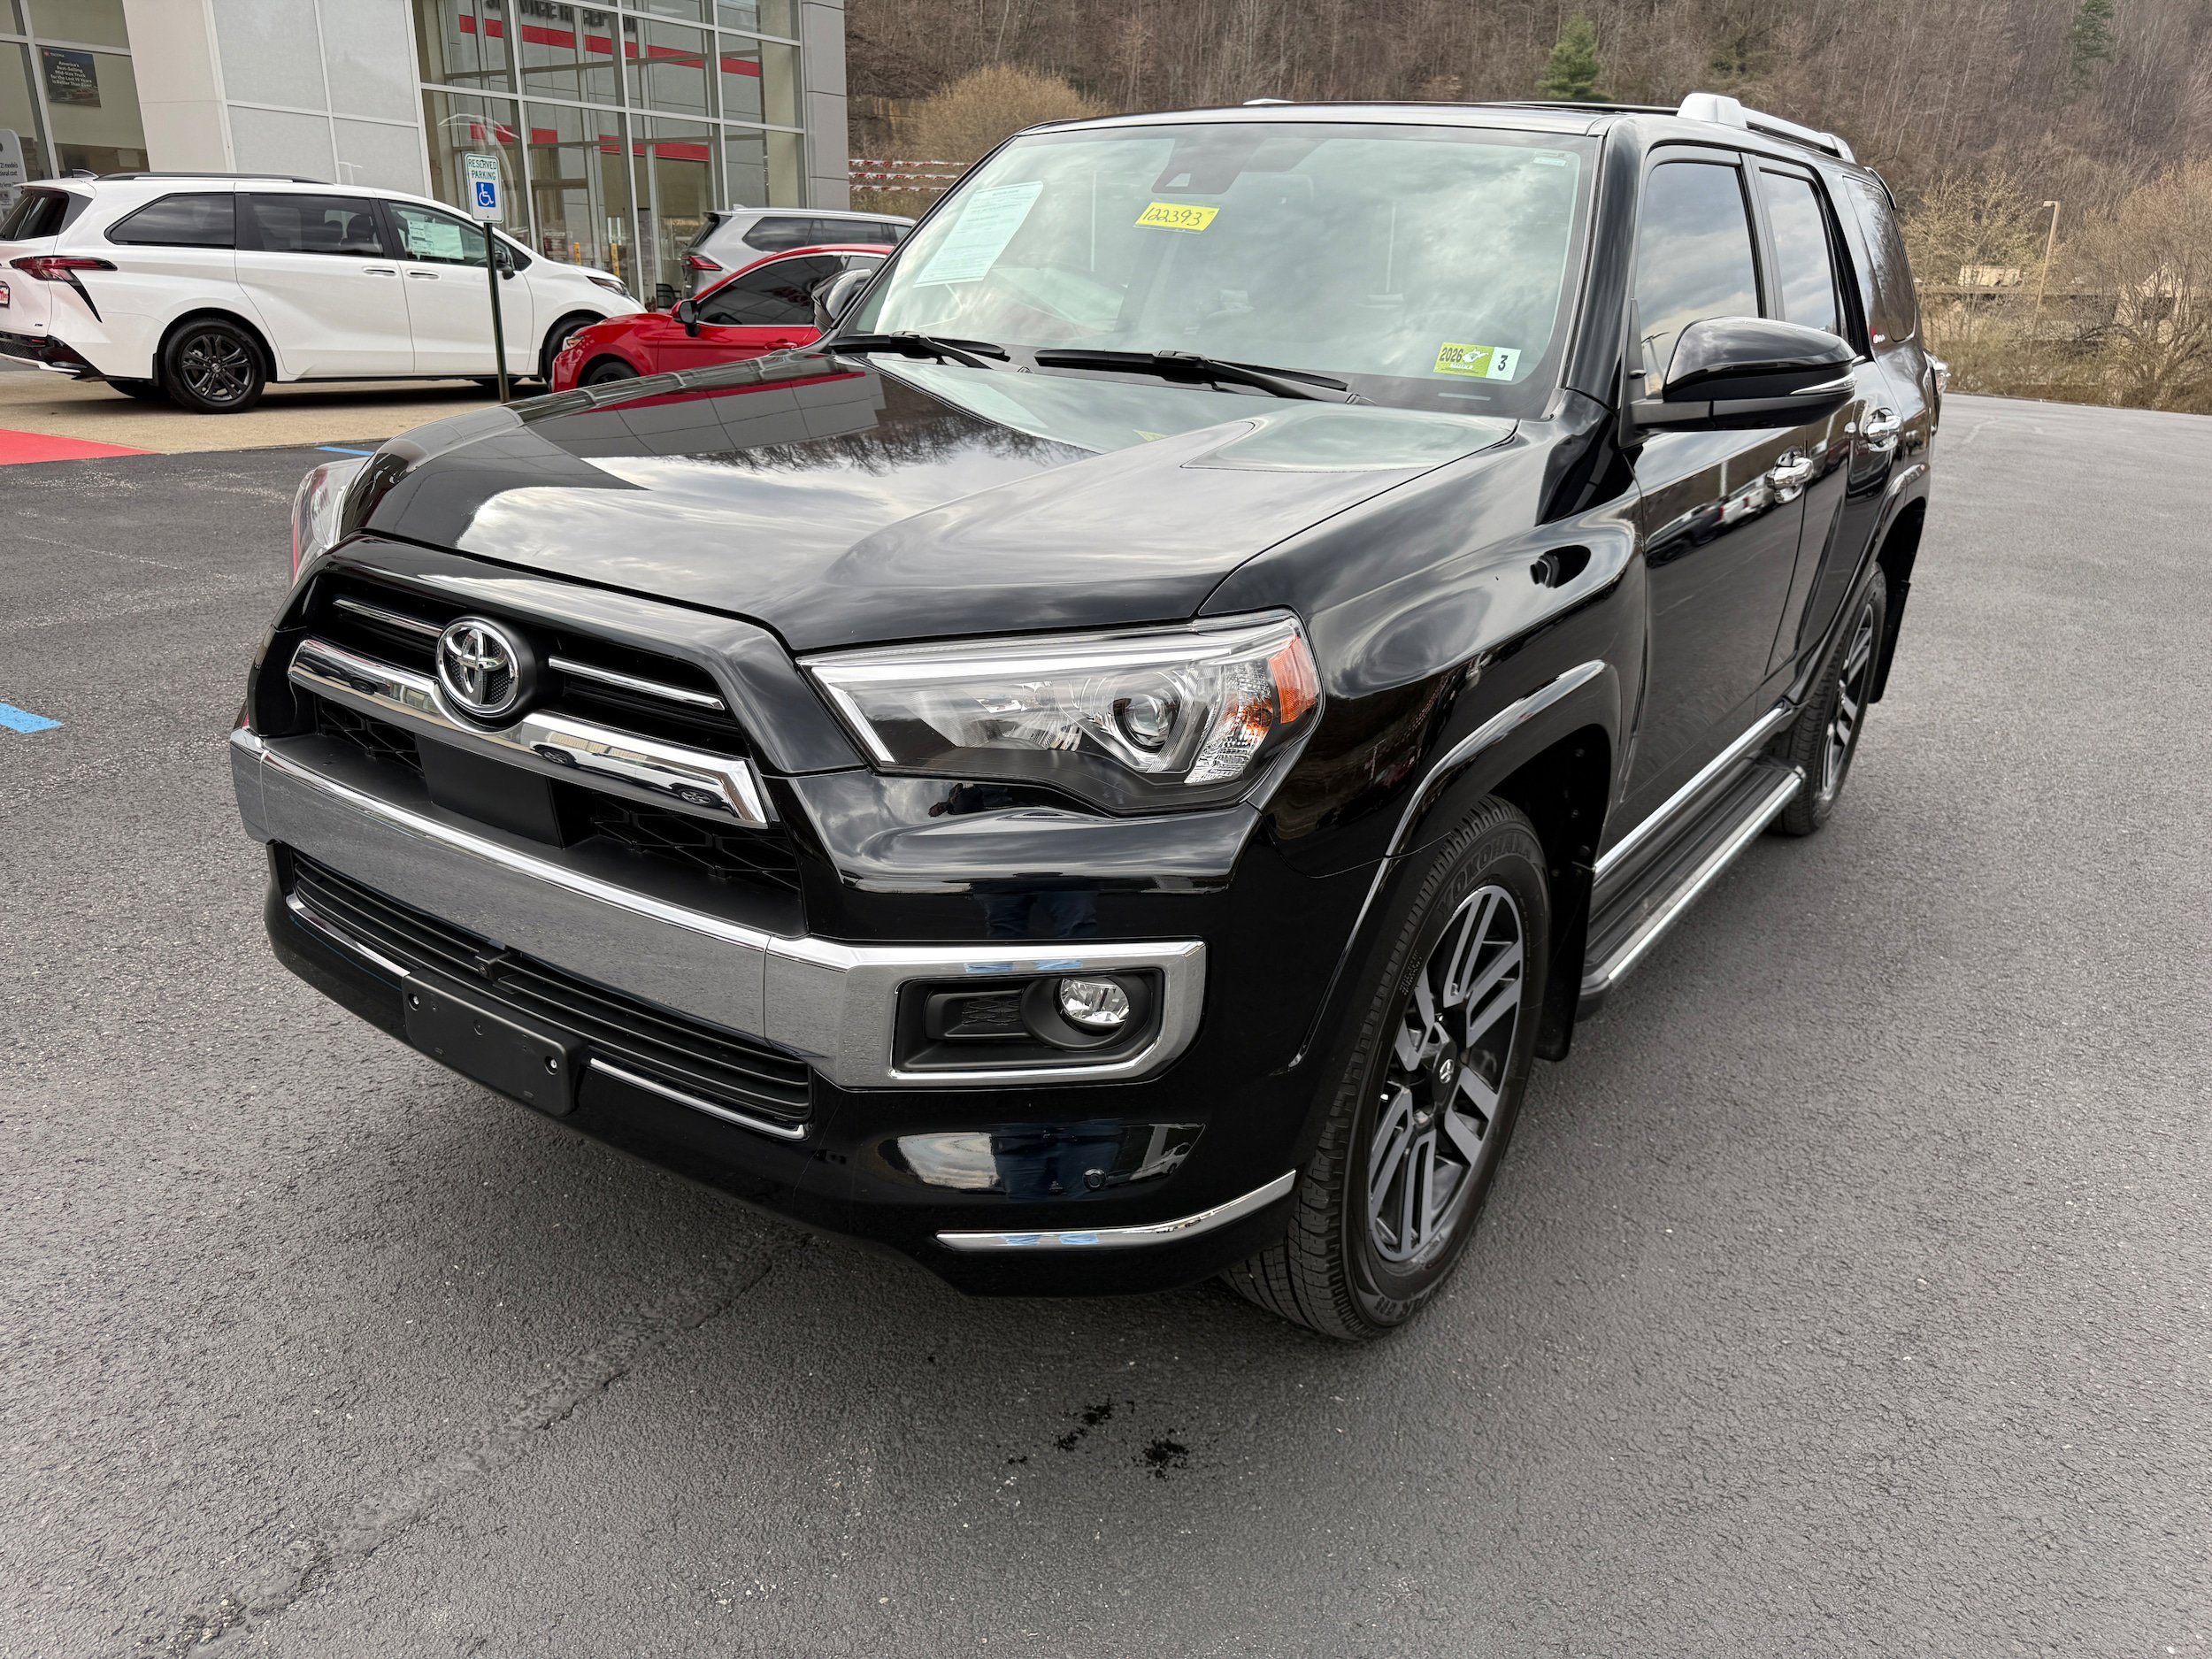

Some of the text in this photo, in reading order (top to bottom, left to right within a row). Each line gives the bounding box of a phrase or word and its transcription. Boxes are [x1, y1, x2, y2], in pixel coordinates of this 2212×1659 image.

[468, 158, 496, 169] RESERVED
[472, 170, 495, 180] PARKING
[1142, 207, 1202, 227] 122393
[1440, 347, 1509, 372] 2026 3
[1436, 833, 1532, 917] YOKOHAMA
